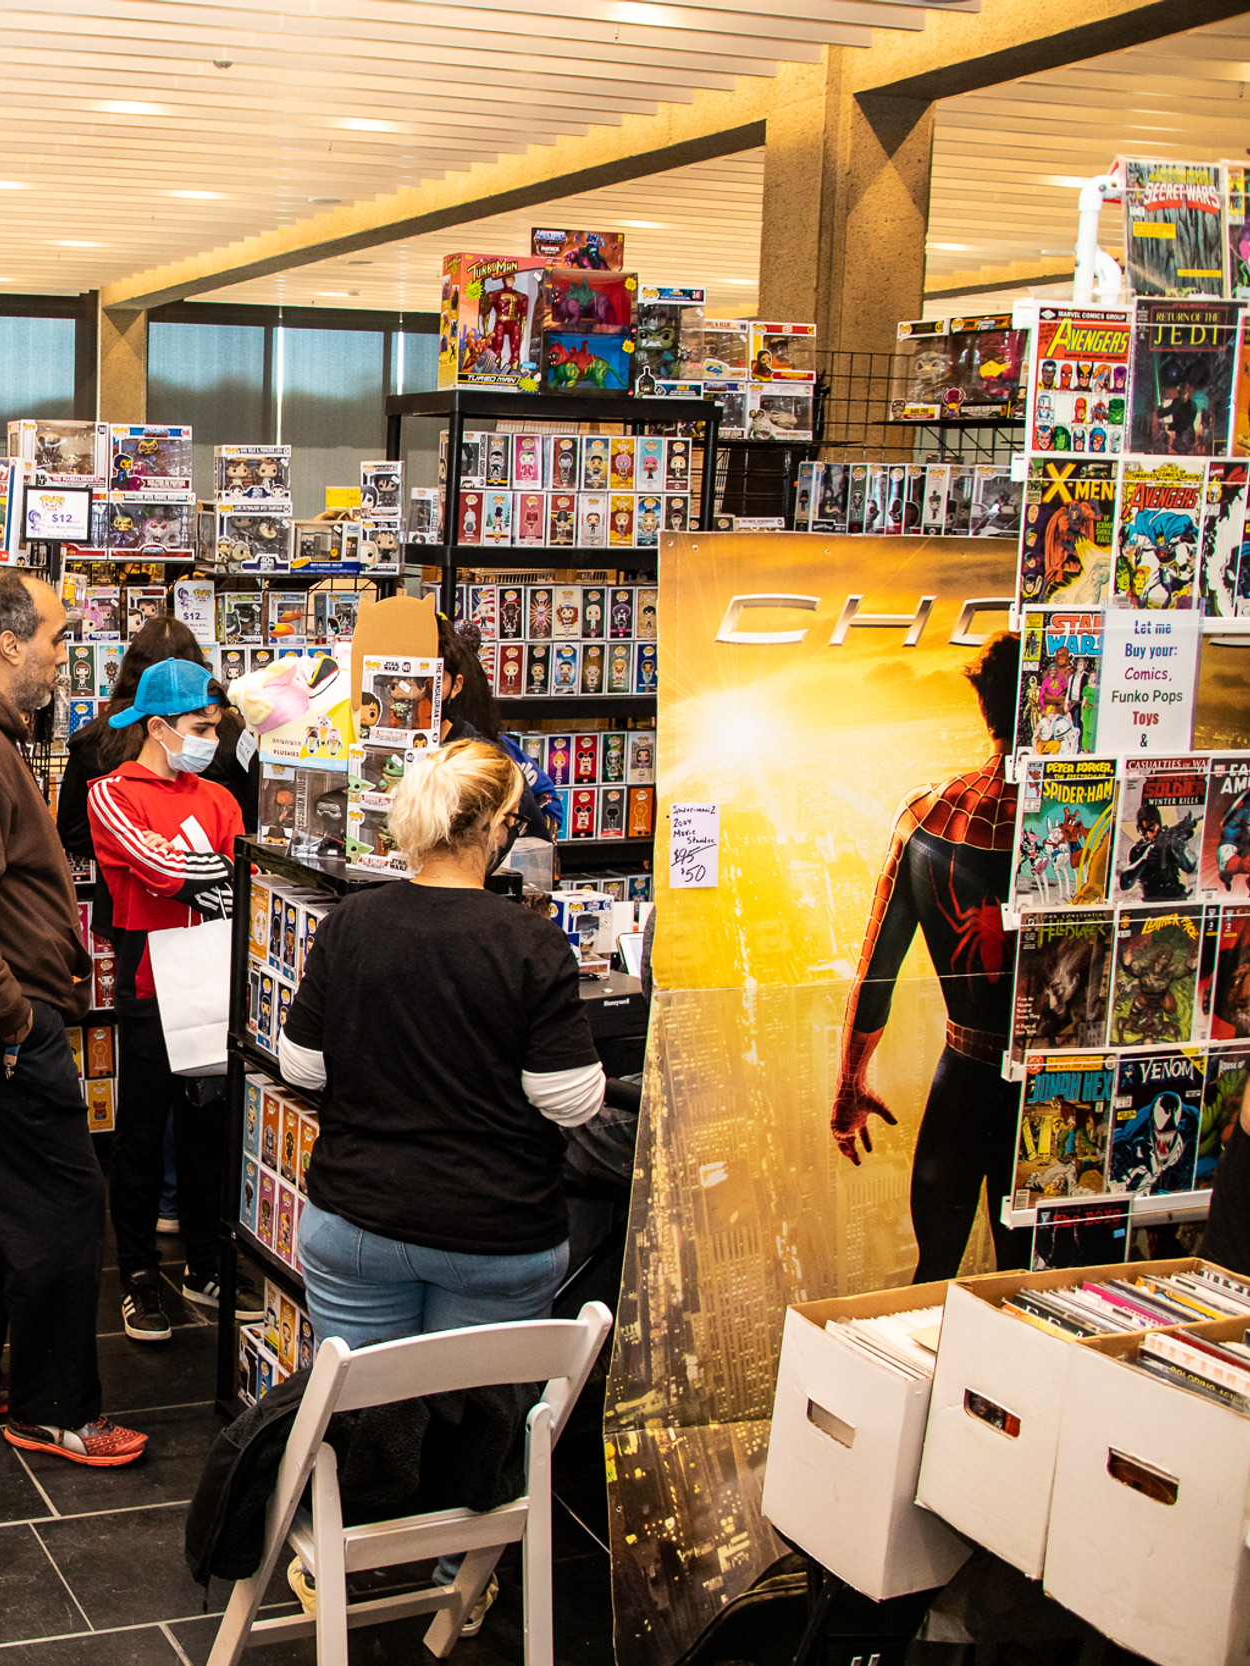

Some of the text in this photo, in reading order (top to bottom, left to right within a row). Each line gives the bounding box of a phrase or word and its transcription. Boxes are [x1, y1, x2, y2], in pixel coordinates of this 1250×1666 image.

[1144, 182, 1221, 210] SECRET WARS
[1058, 310, 1081, 319] MARVEL
[1156, 312, 1221, 322] RETURN OF THE
[1046, 317, 1130, 357] AVENGERS
[1153, 324, 1218, 345] JEDI
[1042, 462, 1114, 504] X-MEN
[1130, 482, 1199, 512] AVENGERS
[183, 612, 201, 620] $12
[1134, 620, 1172, 635] Let me
[1124, 643, 1178, 660] Buy your:
[1124, 667, 1172, 682] Comics,
[433, 675, 442, 718] MANDALORIAN
[1111, 689, 1183, 705] Funko Pops
[1132, 711, 1160, 727] Toys
[1140, 733, 1148, 747] &
[273, 749, 300, 758] PLUSHIES
[1046, 762, 1075, 773] PETER
[1128, 760, 1182, 769] CASUALTIES
[1043, 778, 1114, 804] SPIDER-HAM
[1143, 781, 1206, 798] SOLDIER
[1148, 796, 1199, 805] WINTER KILLS
[673, 818, 692, 828] 2004
[680, 864, 707, 882] $50
[1139, 1057, 1194, 1083] VENOM
[1027, 1071, 1114, 1103] JONAH HEX
